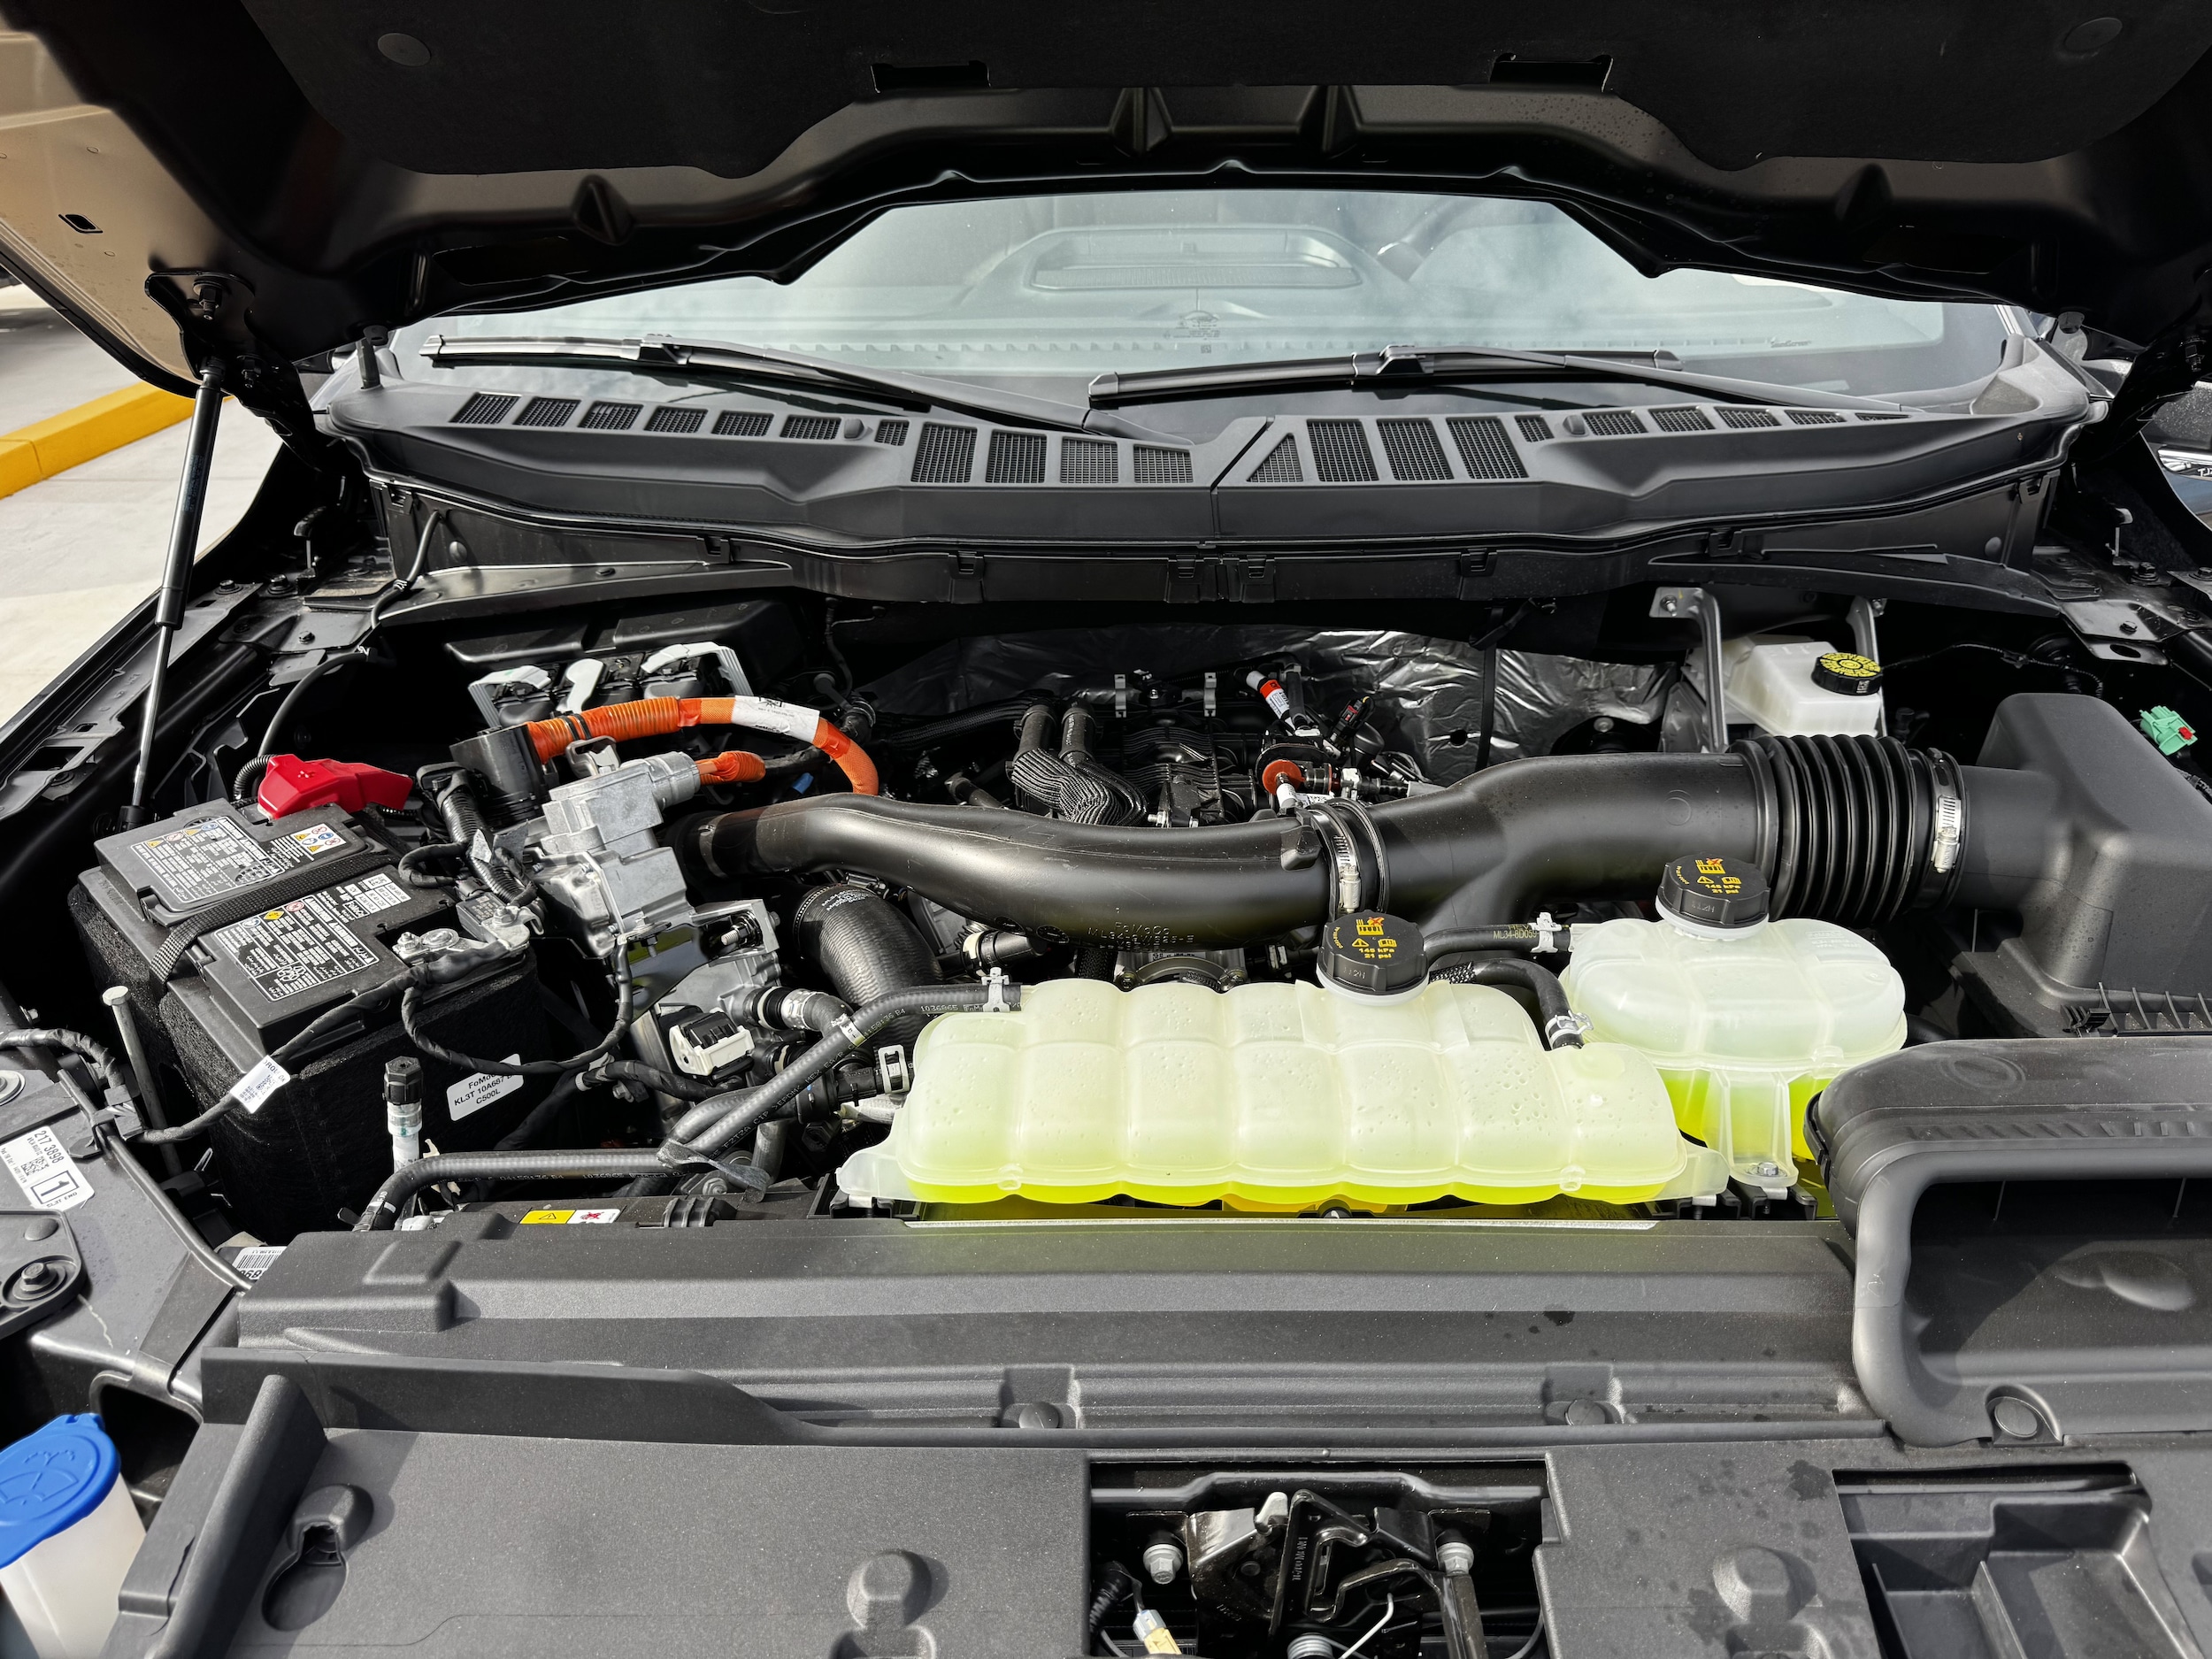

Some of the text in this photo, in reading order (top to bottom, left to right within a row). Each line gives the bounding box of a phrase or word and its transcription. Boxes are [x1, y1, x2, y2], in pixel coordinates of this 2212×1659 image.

[454, 1075, 504, 1106] KL3T 10A687
[476, 1088, 501, 1104] C500L
[35, 1130, 53, 1145] 217
[43, 1144, 65, 1164] 3898
[41, 1180, 70, 1197] 1
